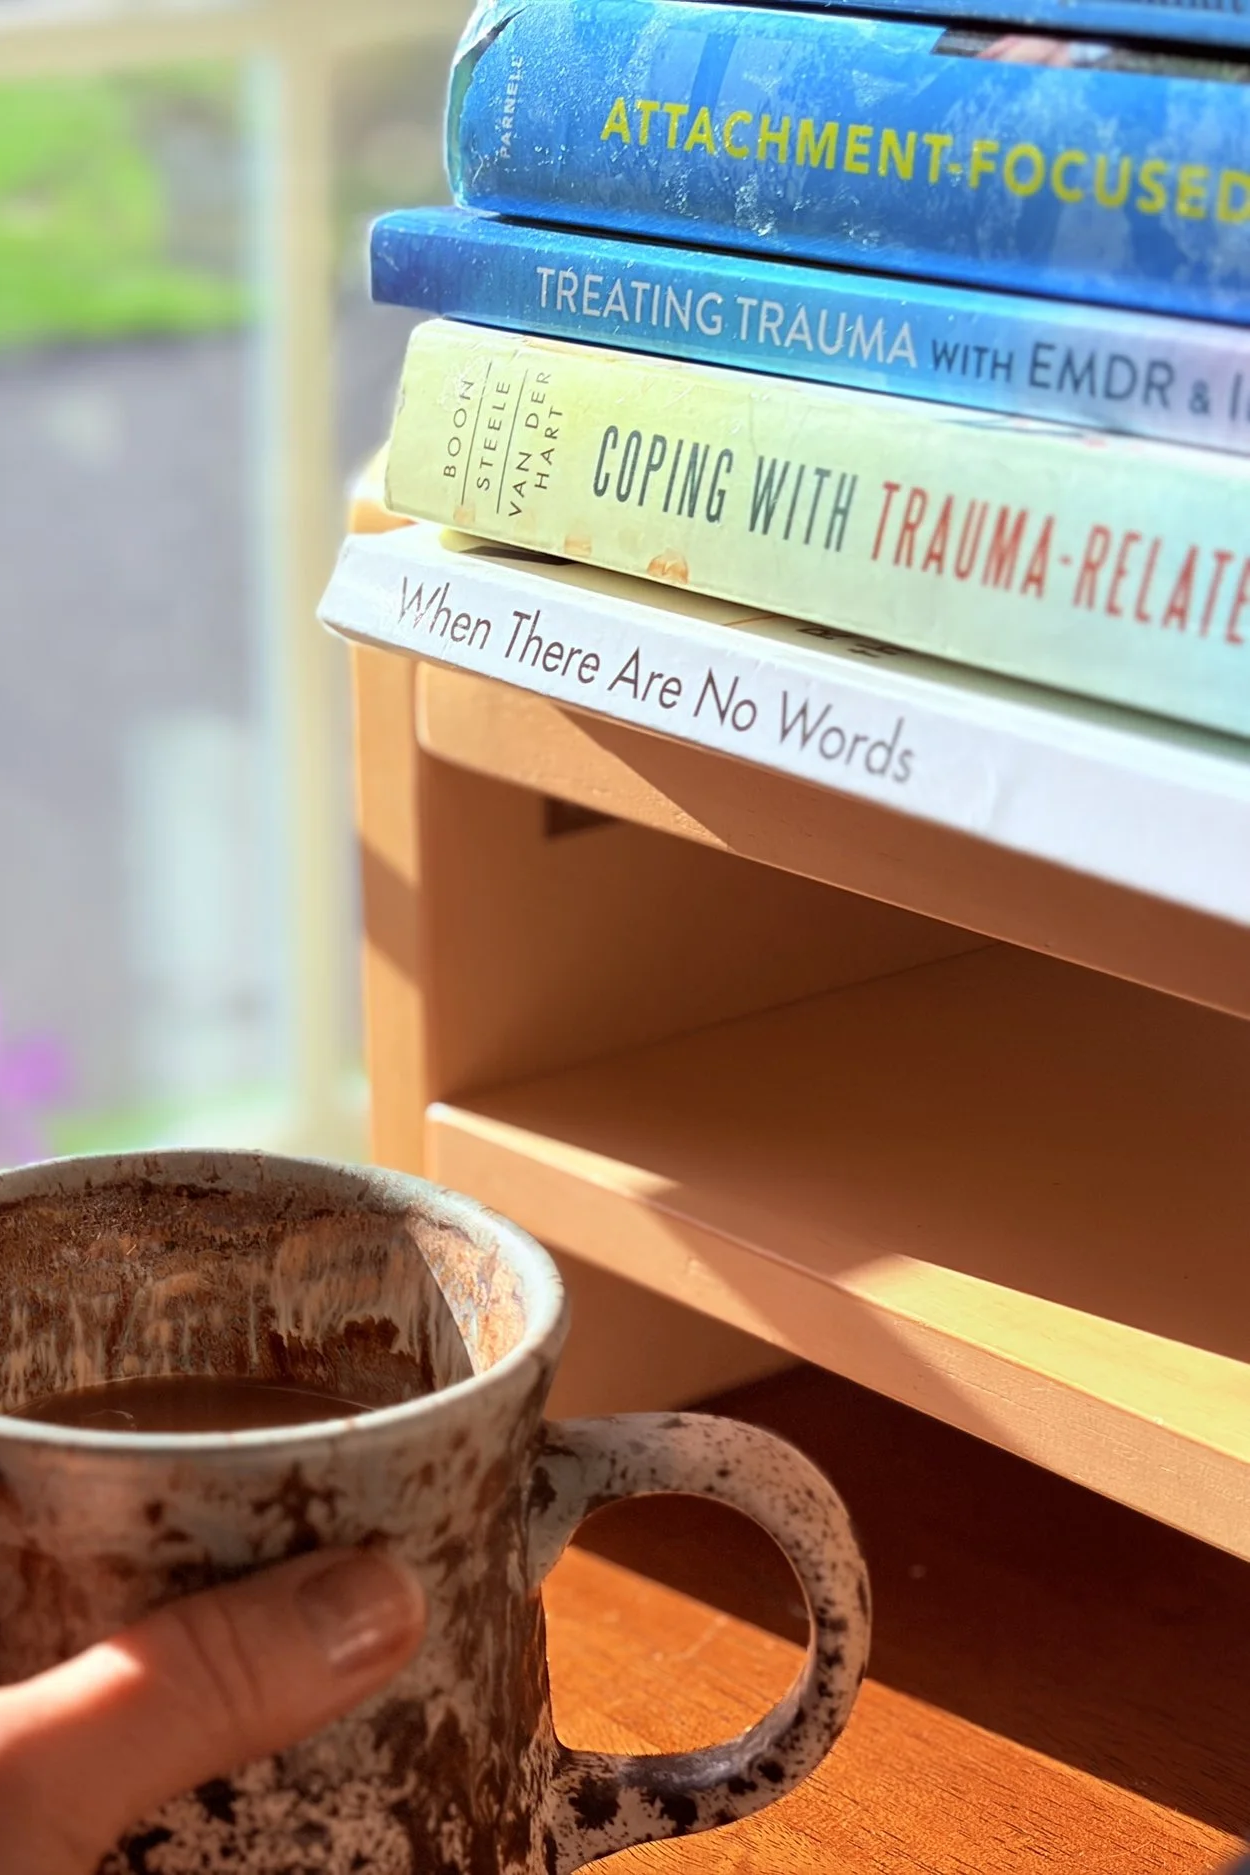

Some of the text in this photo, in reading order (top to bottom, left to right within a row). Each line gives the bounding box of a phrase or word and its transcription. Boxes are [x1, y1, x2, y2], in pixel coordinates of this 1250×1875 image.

[601, 97, 1250, 223] ATTACHMENT-FOCUSED
[537, 266, 724, 336] TREATING
[737, 297, 918, 369] TRAUMA
[932, 339, 1014, 383] WITH
[1029, 342, 1175, 410] EMDR
[1188, 378, 1210, 417] &
[443, 379, 474, 478] BOON
[476, 381, 511, 491] STEELE
[508, 371, 552, 517] VAN DER
[533, 405, 564, 490] HART
[593, 425, 734, 524] COPING
[748, 455, 858, 553] WITH
[400, 576, 915, 785] When There Are No Words
